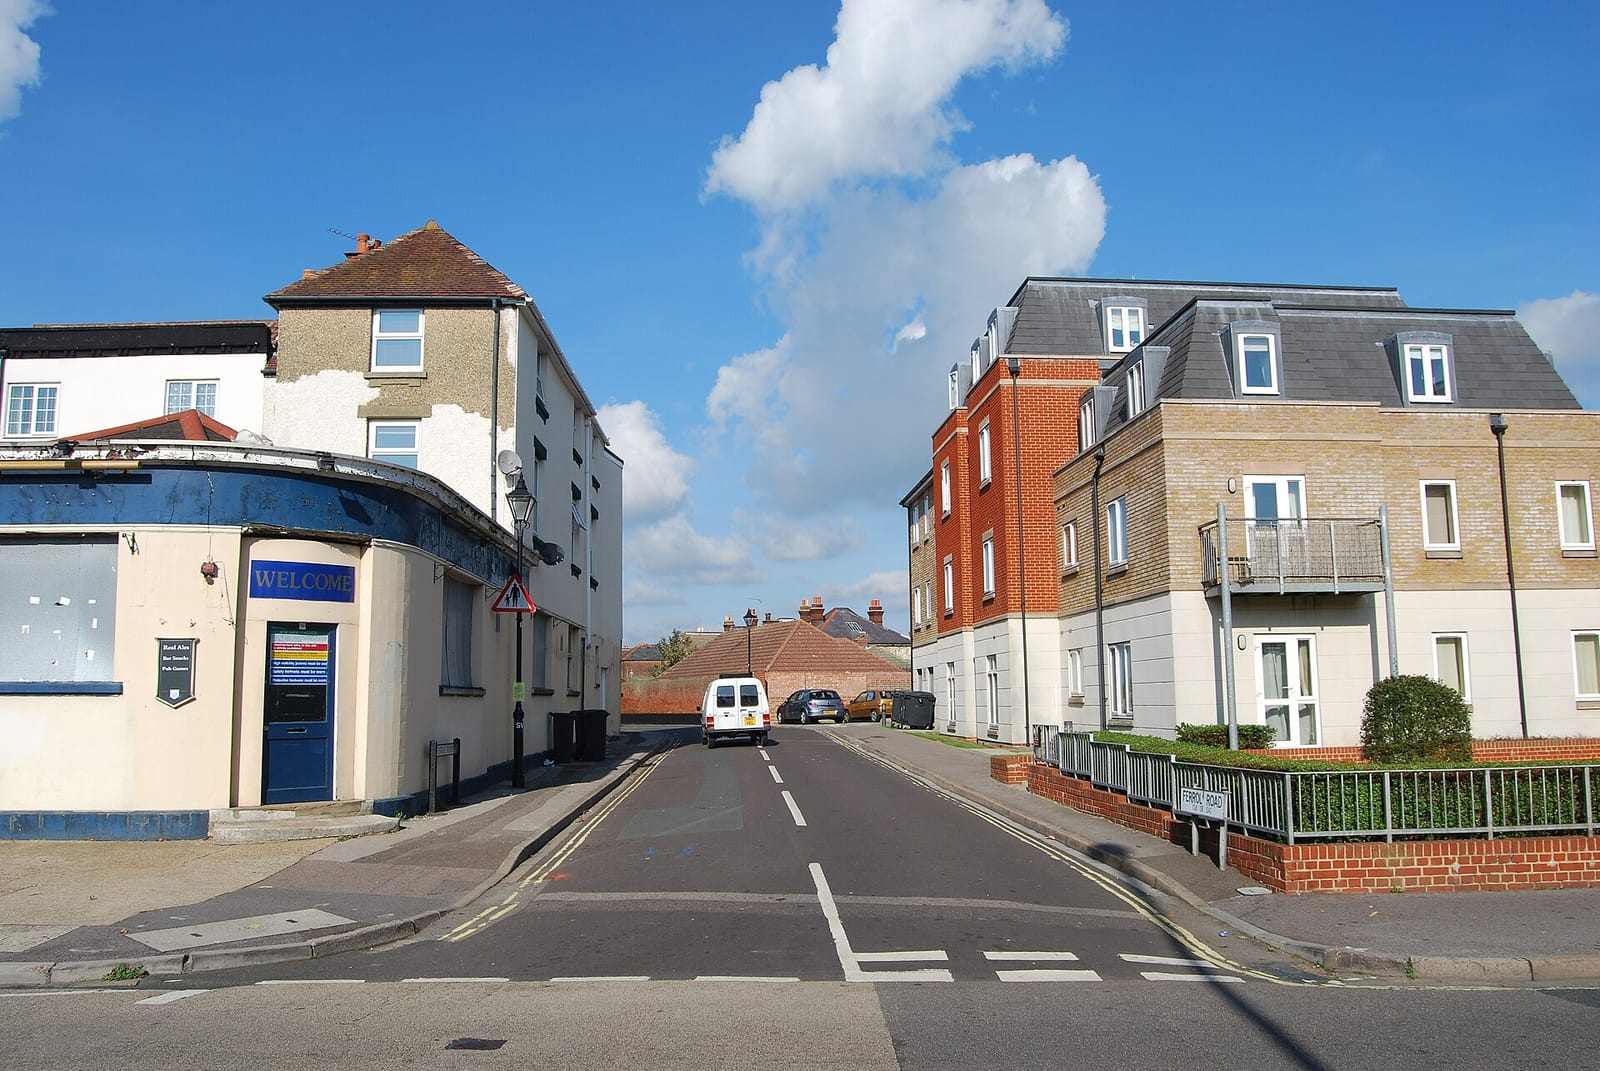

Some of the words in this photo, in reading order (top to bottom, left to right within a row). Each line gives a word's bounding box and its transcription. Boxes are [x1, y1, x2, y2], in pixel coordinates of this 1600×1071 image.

[255, 570, 353, 592] WELCOME
[1183, 790, 1202, 804] FERROL
[1206, 794, 1222, 808] ROAD
